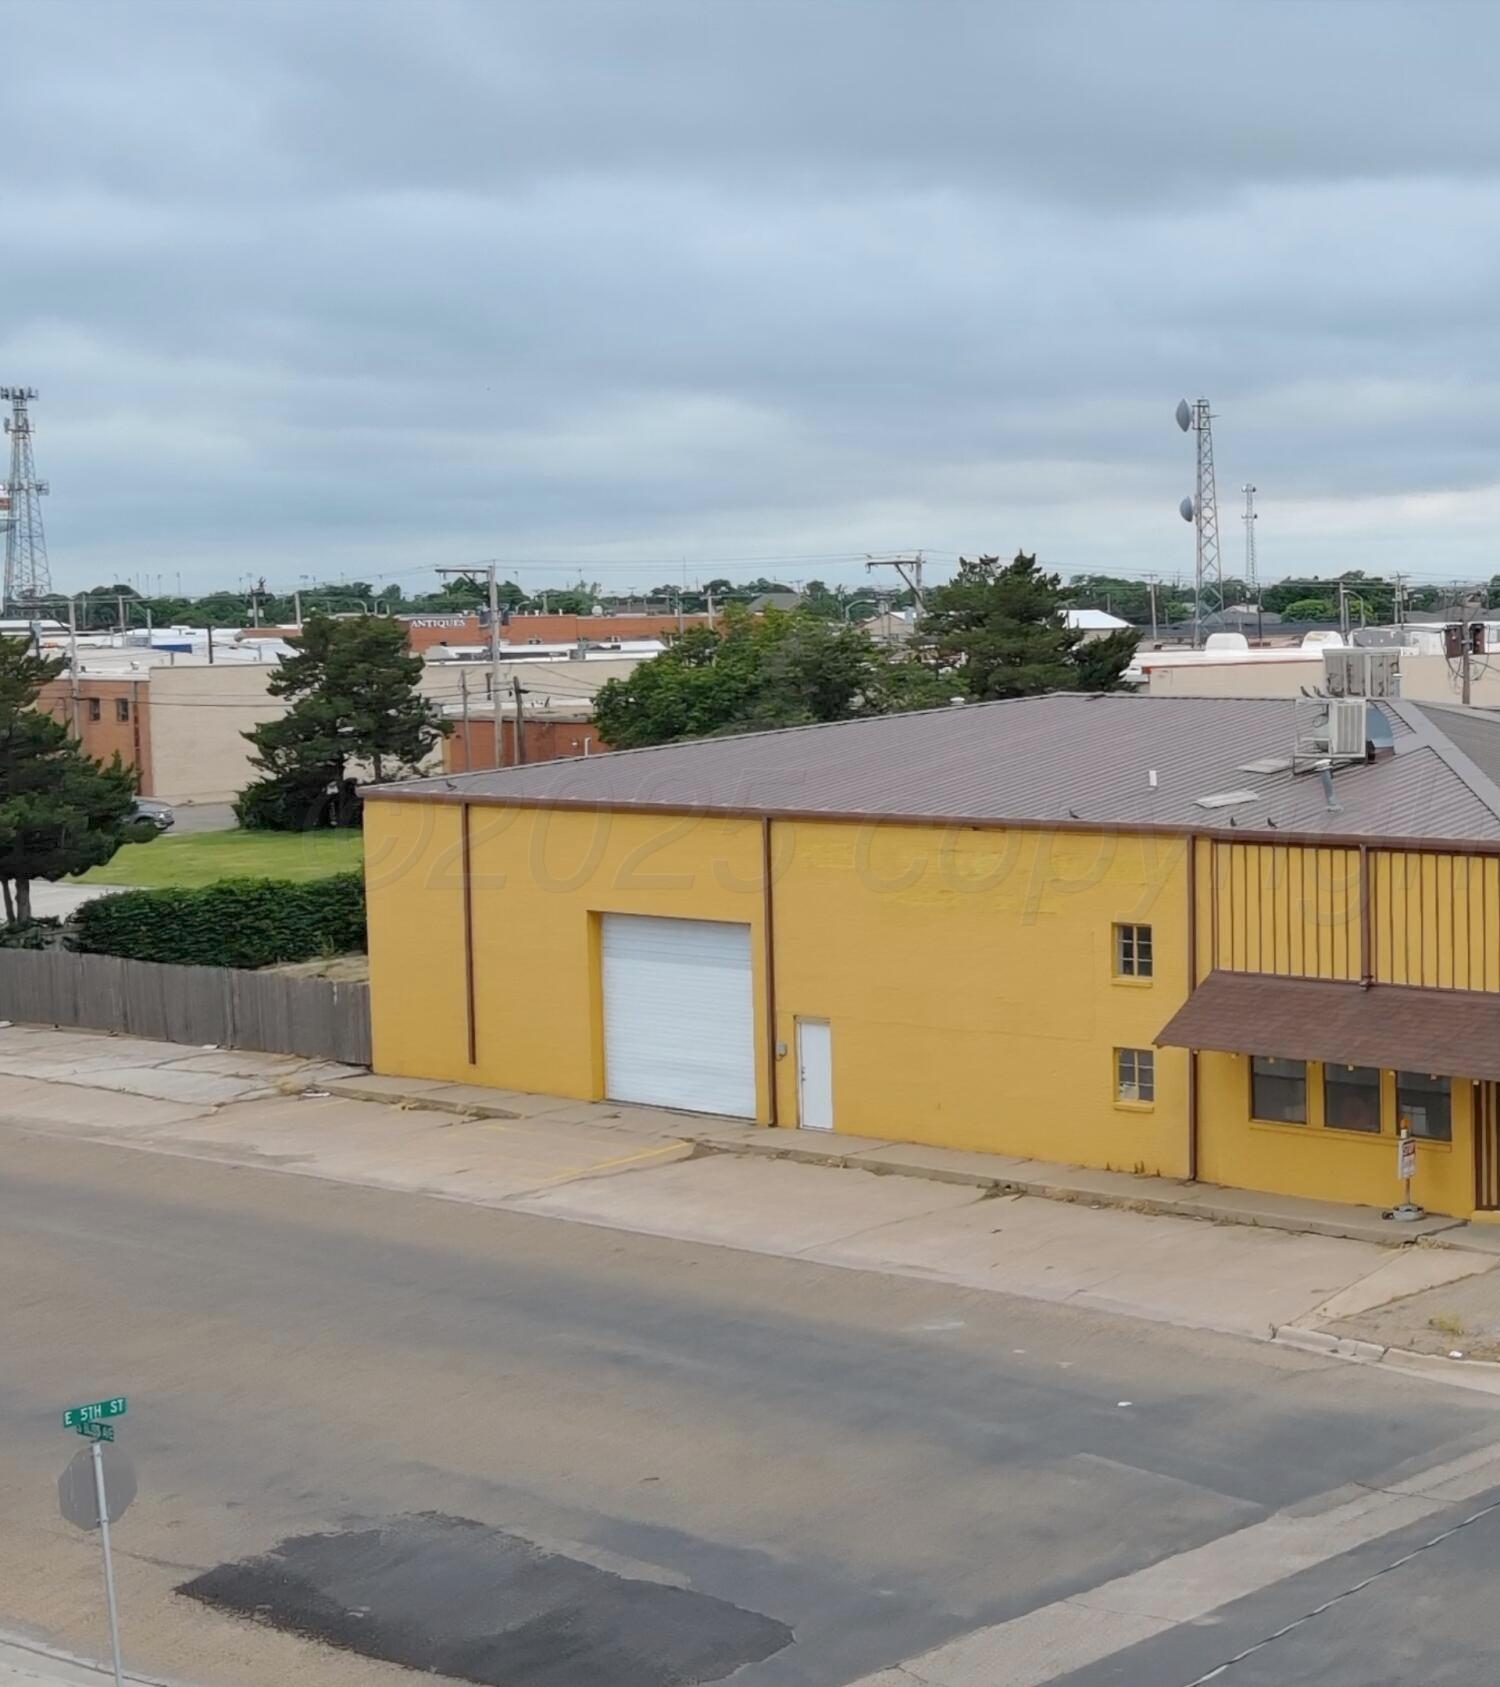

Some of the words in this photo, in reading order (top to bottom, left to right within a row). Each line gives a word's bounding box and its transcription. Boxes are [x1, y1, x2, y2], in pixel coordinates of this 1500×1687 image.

[411, 619, 466, 629] ANTIQUES
[65, 1411, 72, 1425] E
[80, 1405, 102, 1421] 5TH
[110, 1399, 124, 1413] ST
